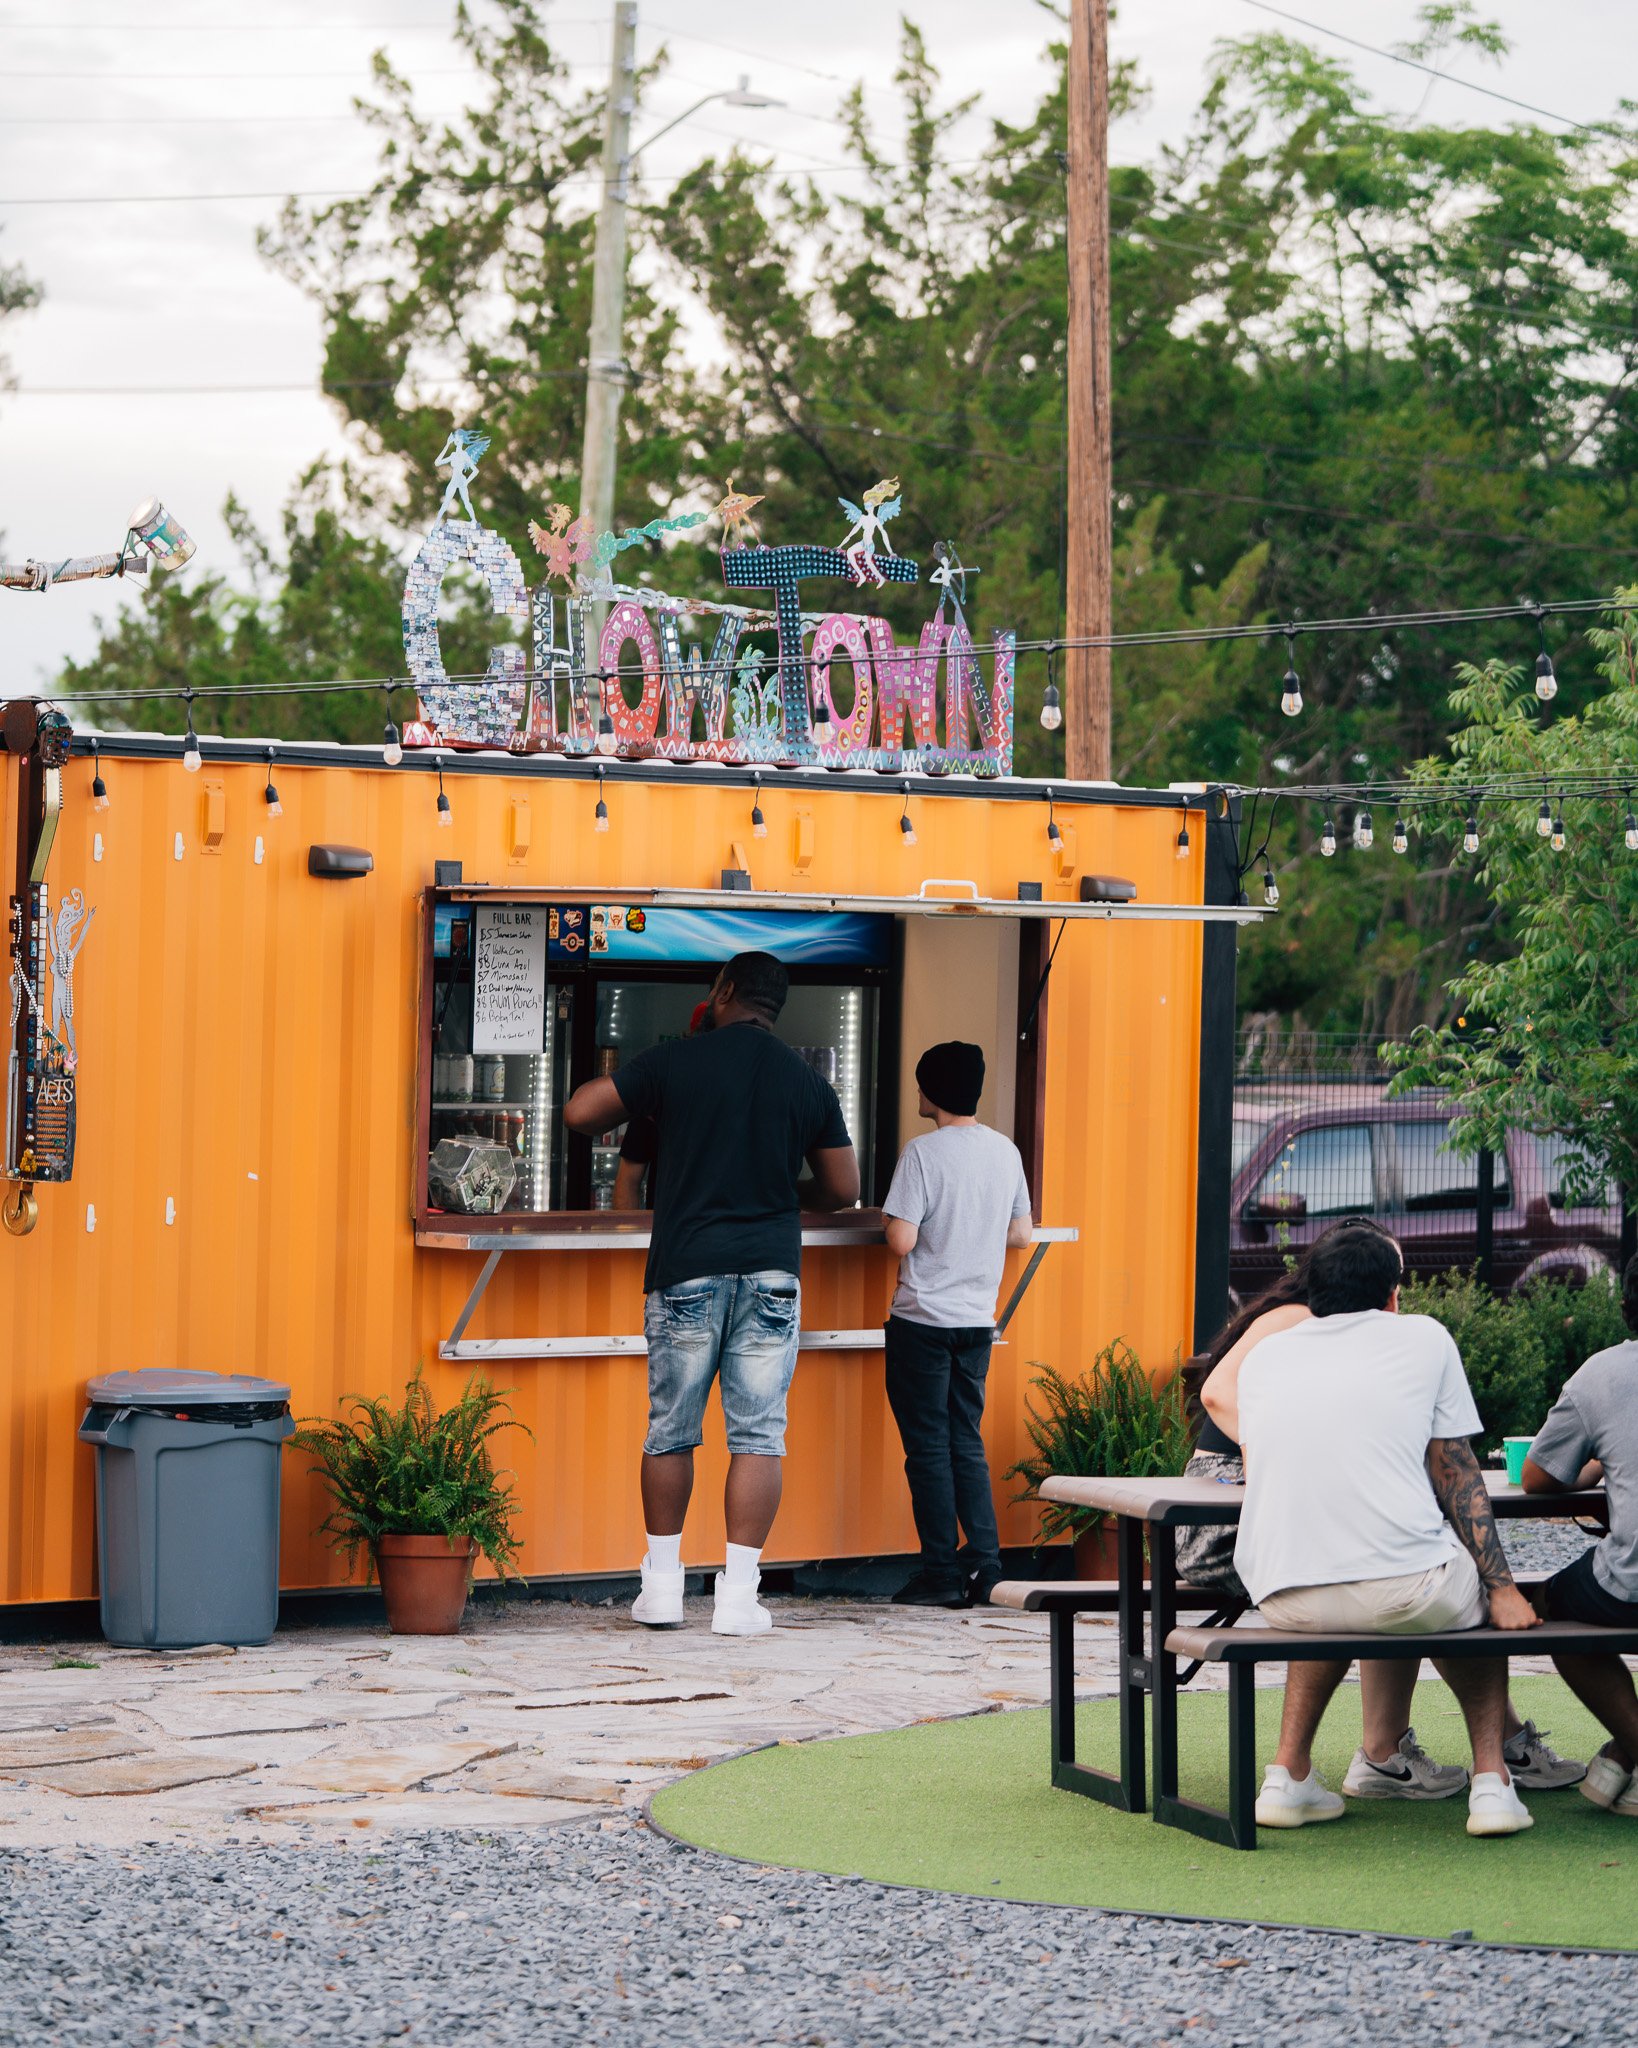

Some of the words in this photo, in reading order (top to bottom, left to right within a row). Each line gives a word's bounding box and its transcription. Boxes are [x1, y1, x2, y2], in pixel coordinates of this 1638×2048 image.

[493, 912, 512, 925] FULL
[515, 912, 532, 926] BAR
[480, 928, 493, 942] $5
[478, 943, 491, 956] $7
[478, 953, 490, 970] $8
[477, 970, 490, 984] $7
[477, 984, 488, 996] $2
[476, 996, 487, 1009] $8
[489, 994, 511, 1010] RUM
[512, 993, 538, 1010] Punch
[475, 1010, 487, 1025] $6
[36, 1077, 74, 1107] ARTS
